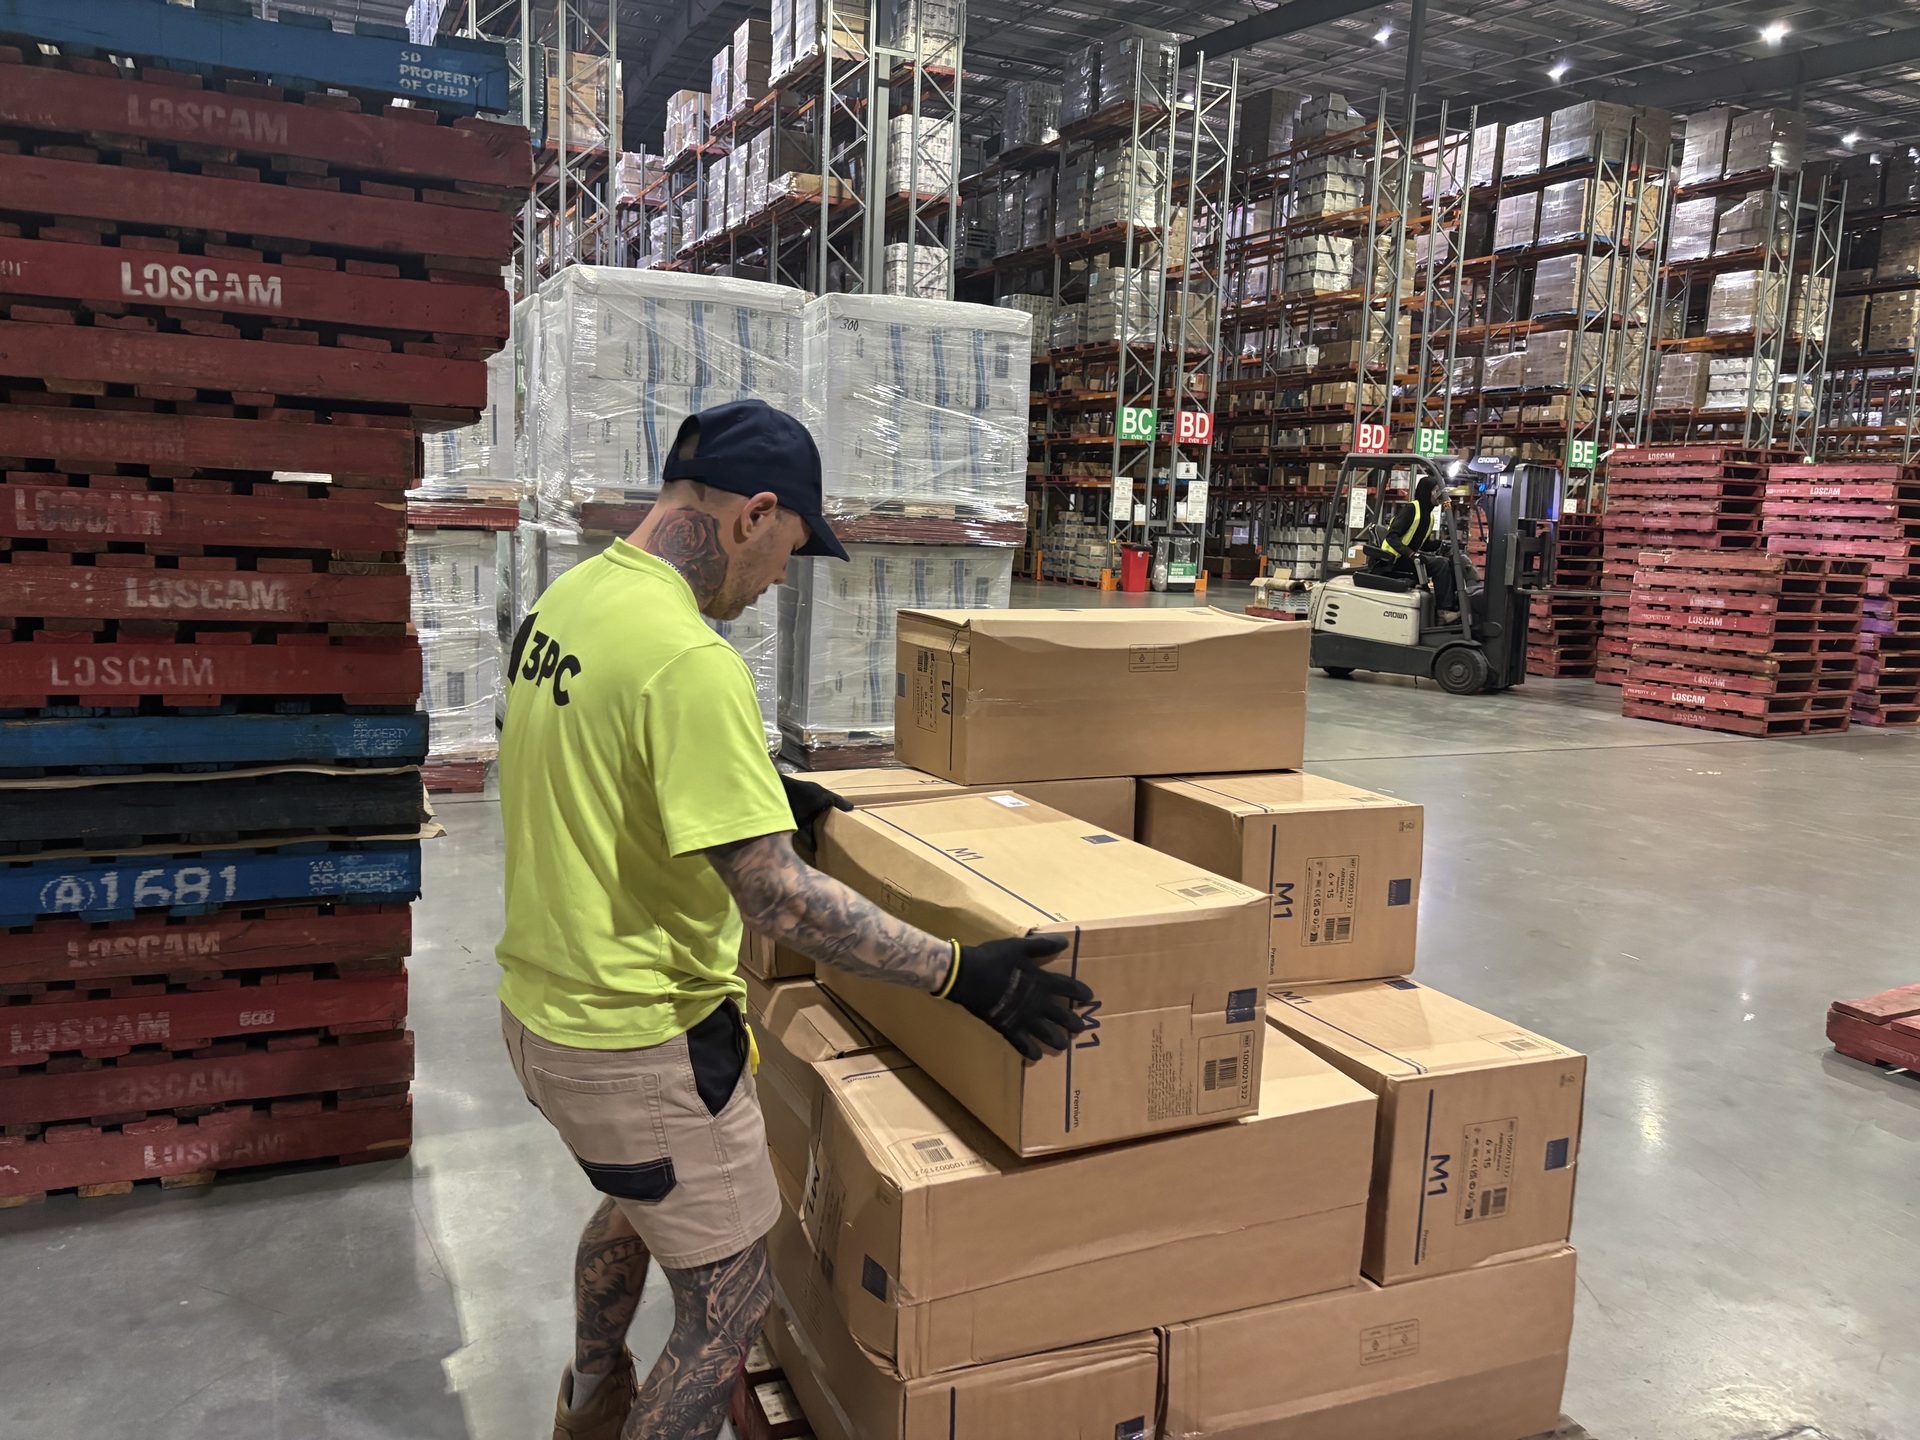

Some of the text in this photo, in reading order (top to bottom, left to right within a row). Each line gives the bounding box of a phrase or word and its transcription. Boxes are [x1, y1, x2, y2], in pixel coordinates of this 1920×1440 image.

[400, 51, 421, 62] SD
[400, 64, 483, 88] PROPERTY
[400, 78, 468, 98] OF CHEP
[127, 94, 288, 145] LOSCAM
[120, 261, 283, 309] LOSCAM
[839, 318, 859, 331] 300
[1121, 407, 1153, 435] BC
[1179, 411, 1210, 438] BD
[1358, 423, 1385, 449] BD
[1419, 428, 1445, 453] BE
[1571, 440, 1595, 463] BE
[1648, 452, 1675, 460] LOSCAM
[1809, 487, 1841, 496] LOSCAM
[125, 577, 288, 611] LOSCAM
[1383, 610, 1408, 620] CROWN
[1688, 615, 1723, 627] LOSCAM
[50, 656, 215, 686] LOSCAM
[1693, 675, 1726, 688] LOSCAM
[941, 679, 951, 714] M1
[1671, 692, 1706, 704] LOSCAM
[945, 847, 985, 861] M1
[1273, 883, 1295, 919] M1
[1326, 888, 1334, 899] 15
[67, 931, 221, 967] LOSCAM
[1274, 991, 1313, 1005] M1
[10, 1011, 171, 1054] LOSCAM
[1075, 1001, 1102, 1049] M1
[100, 1067, 246, 1106] LOSCAM
[1241, 1050, 1250, 1100] 1000021322
[1073, 1089, 1081, 1129] Premium
[143, 1133, 284, 1169] LOSCAM
[1427, 1154, 1451, 1196] M1
